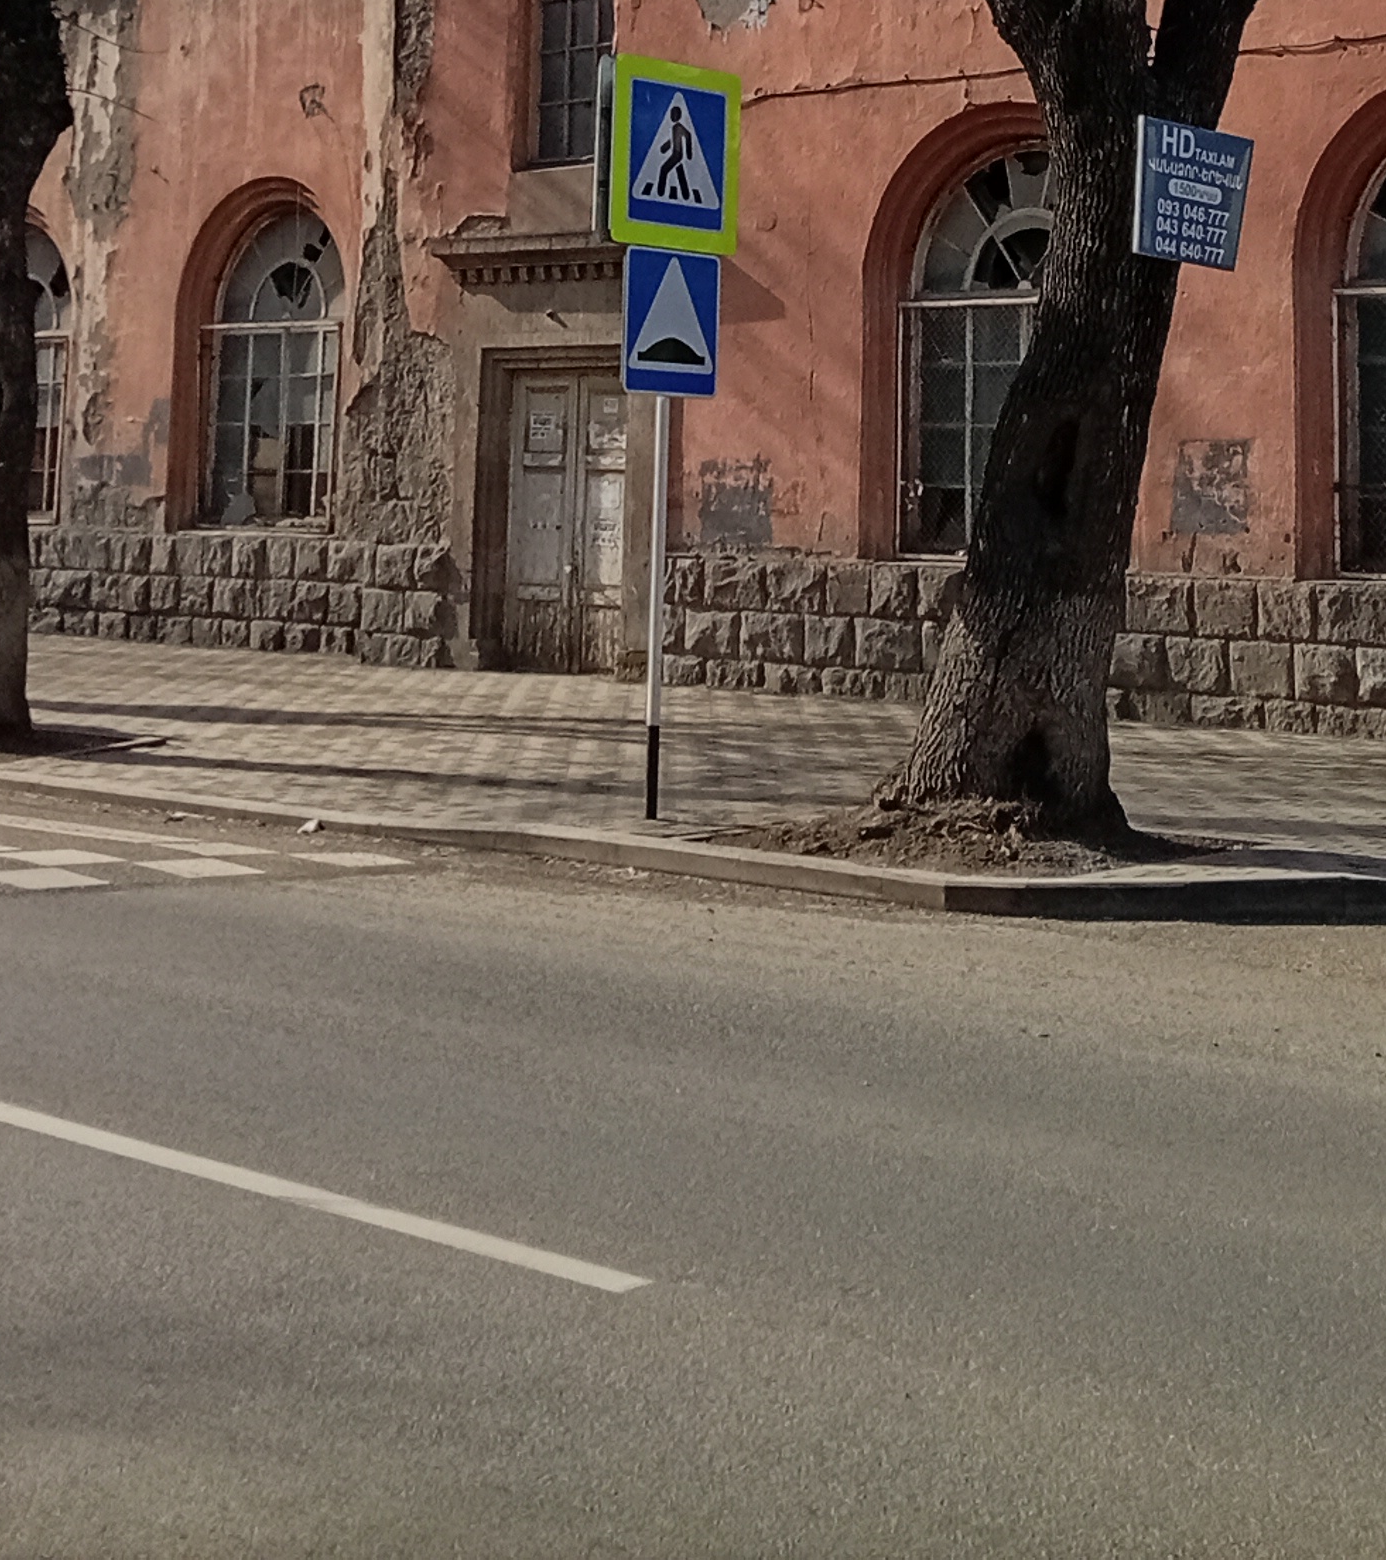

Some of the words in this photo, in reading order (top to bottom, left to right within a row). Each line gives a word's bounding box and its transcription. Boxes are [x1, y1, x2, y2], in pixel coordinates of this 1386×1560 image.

[1161, 124, 1196, 159] HD
[1157, 198, 1180, 217] 093
[1182, 203, 1230, 227] 046-777
[1156, 216, 1178, 236] 043
[1181, 221, 1228, 245] 640-777
[1155, 236, 1177, 255] 044
[1179, 241, 1225, 265] 640-777
